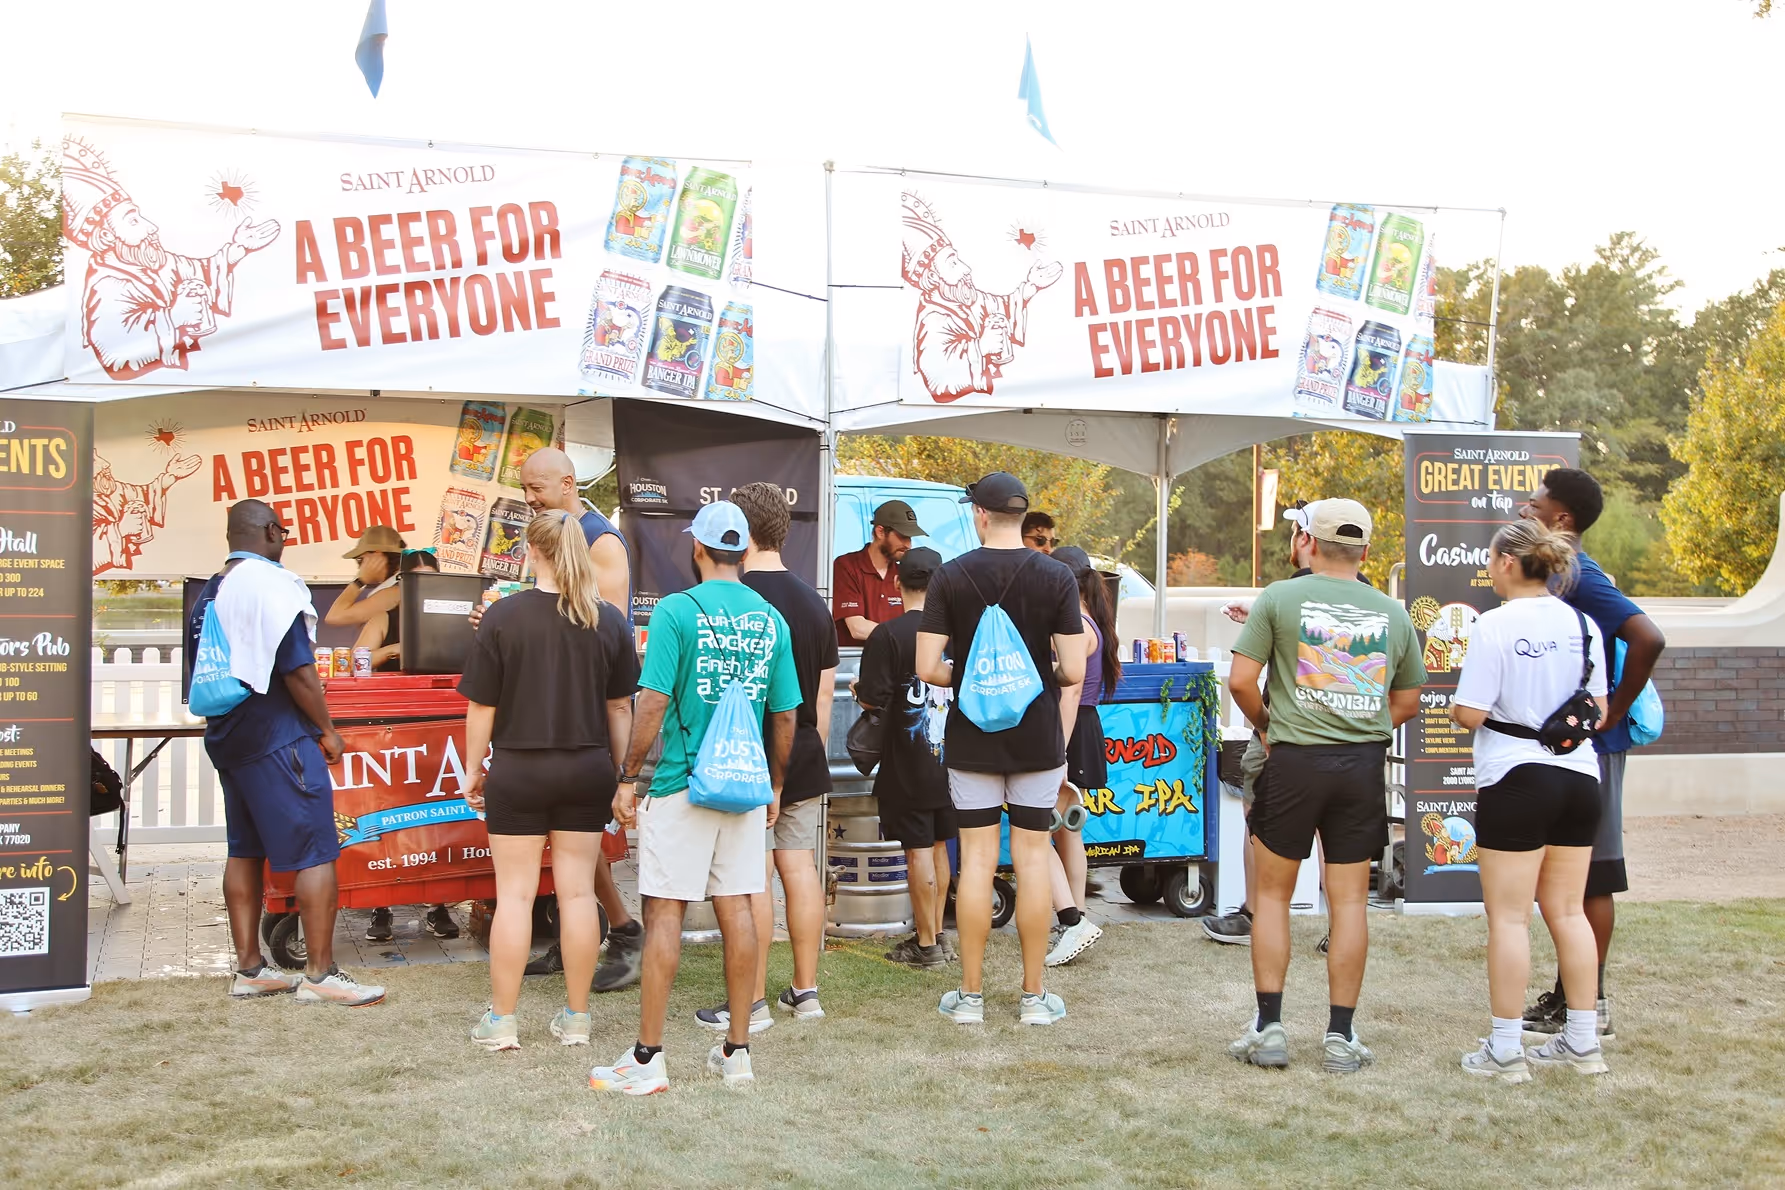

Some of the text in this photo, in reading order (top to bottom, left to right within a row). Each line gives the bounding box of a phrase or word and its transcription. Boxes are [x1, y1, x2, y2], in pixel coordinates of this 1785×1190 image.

[340, 164, 496, 194] SAINT ARNOLD
[1109, 212, 1230, 239] SAINT ARNOLD
[295, 200, 562, 284] A BEER FOR
[671, 245, 721, 270] LAWNMOWER
[1074, 243, 1282, 317] A BEER FOR
[314, 267, 562, 351] EVERYONE
[659, 299, 712, 320] SAINT ARNOLD
[1088, 305, 1279, 378] EVERYONE
[584, 349, 612, 368] GRAND
[612, 356, 635, 374] PRIZE
[682, 375, 696, 389] IPA
[247, 408, 367, 433] SAINT ARNOLD
[1453, 448, 1530, 464] SAINT ARNOLD
[213, 434, 418, 502] A BEER FOR
[1420, 460, 1561, 494] GREAT EVENT
[630, 483, 667, 496] HOUSTON
[700, 487, 722, 504] ST
[1471, 490, 1513, 514] on tap
[226, 487, 415, 547] ERYONE
[13, 559, 39, 568] EVENT
[40, 560, 65, 569] SPACE
[5, 573, 21, 583] 300
[1470, 579, 1493, 587] AT SAINT
[5, 588, 44, 597] UP TO 224
[731, 615, 765, 632] Like
[0, 631, 70, 657] ors Pub
[697, 629, 773, 660] Rocket
[35, 662, 67, 672] SETTING
[4, 677, 20, 687] 100
[696, 674, 767, 700] a Sar
[3, 691, 38, 701] UP TO 60
[1420, 690, 1446, 708] enjoy
[4, 748, 34, 756] MEETINGS
[1450, 767, 1466, 776] SAINT
[6, 785, 39, 793] REHEARSAL
[40, 784, 65, 792] DINNERS
[1134, 778, 1199, 817] IPA
[381, 810, 428, 826] PATRON
[430, 805, 466, 818] SAINT
[1416, 801, 1448, 812] SAINT
[5, 834, 31, 845] 77020
[20, 856, 53, 880] info
[368, 857, 397, 870] est.
[401, 851, 437, 867] 1994
